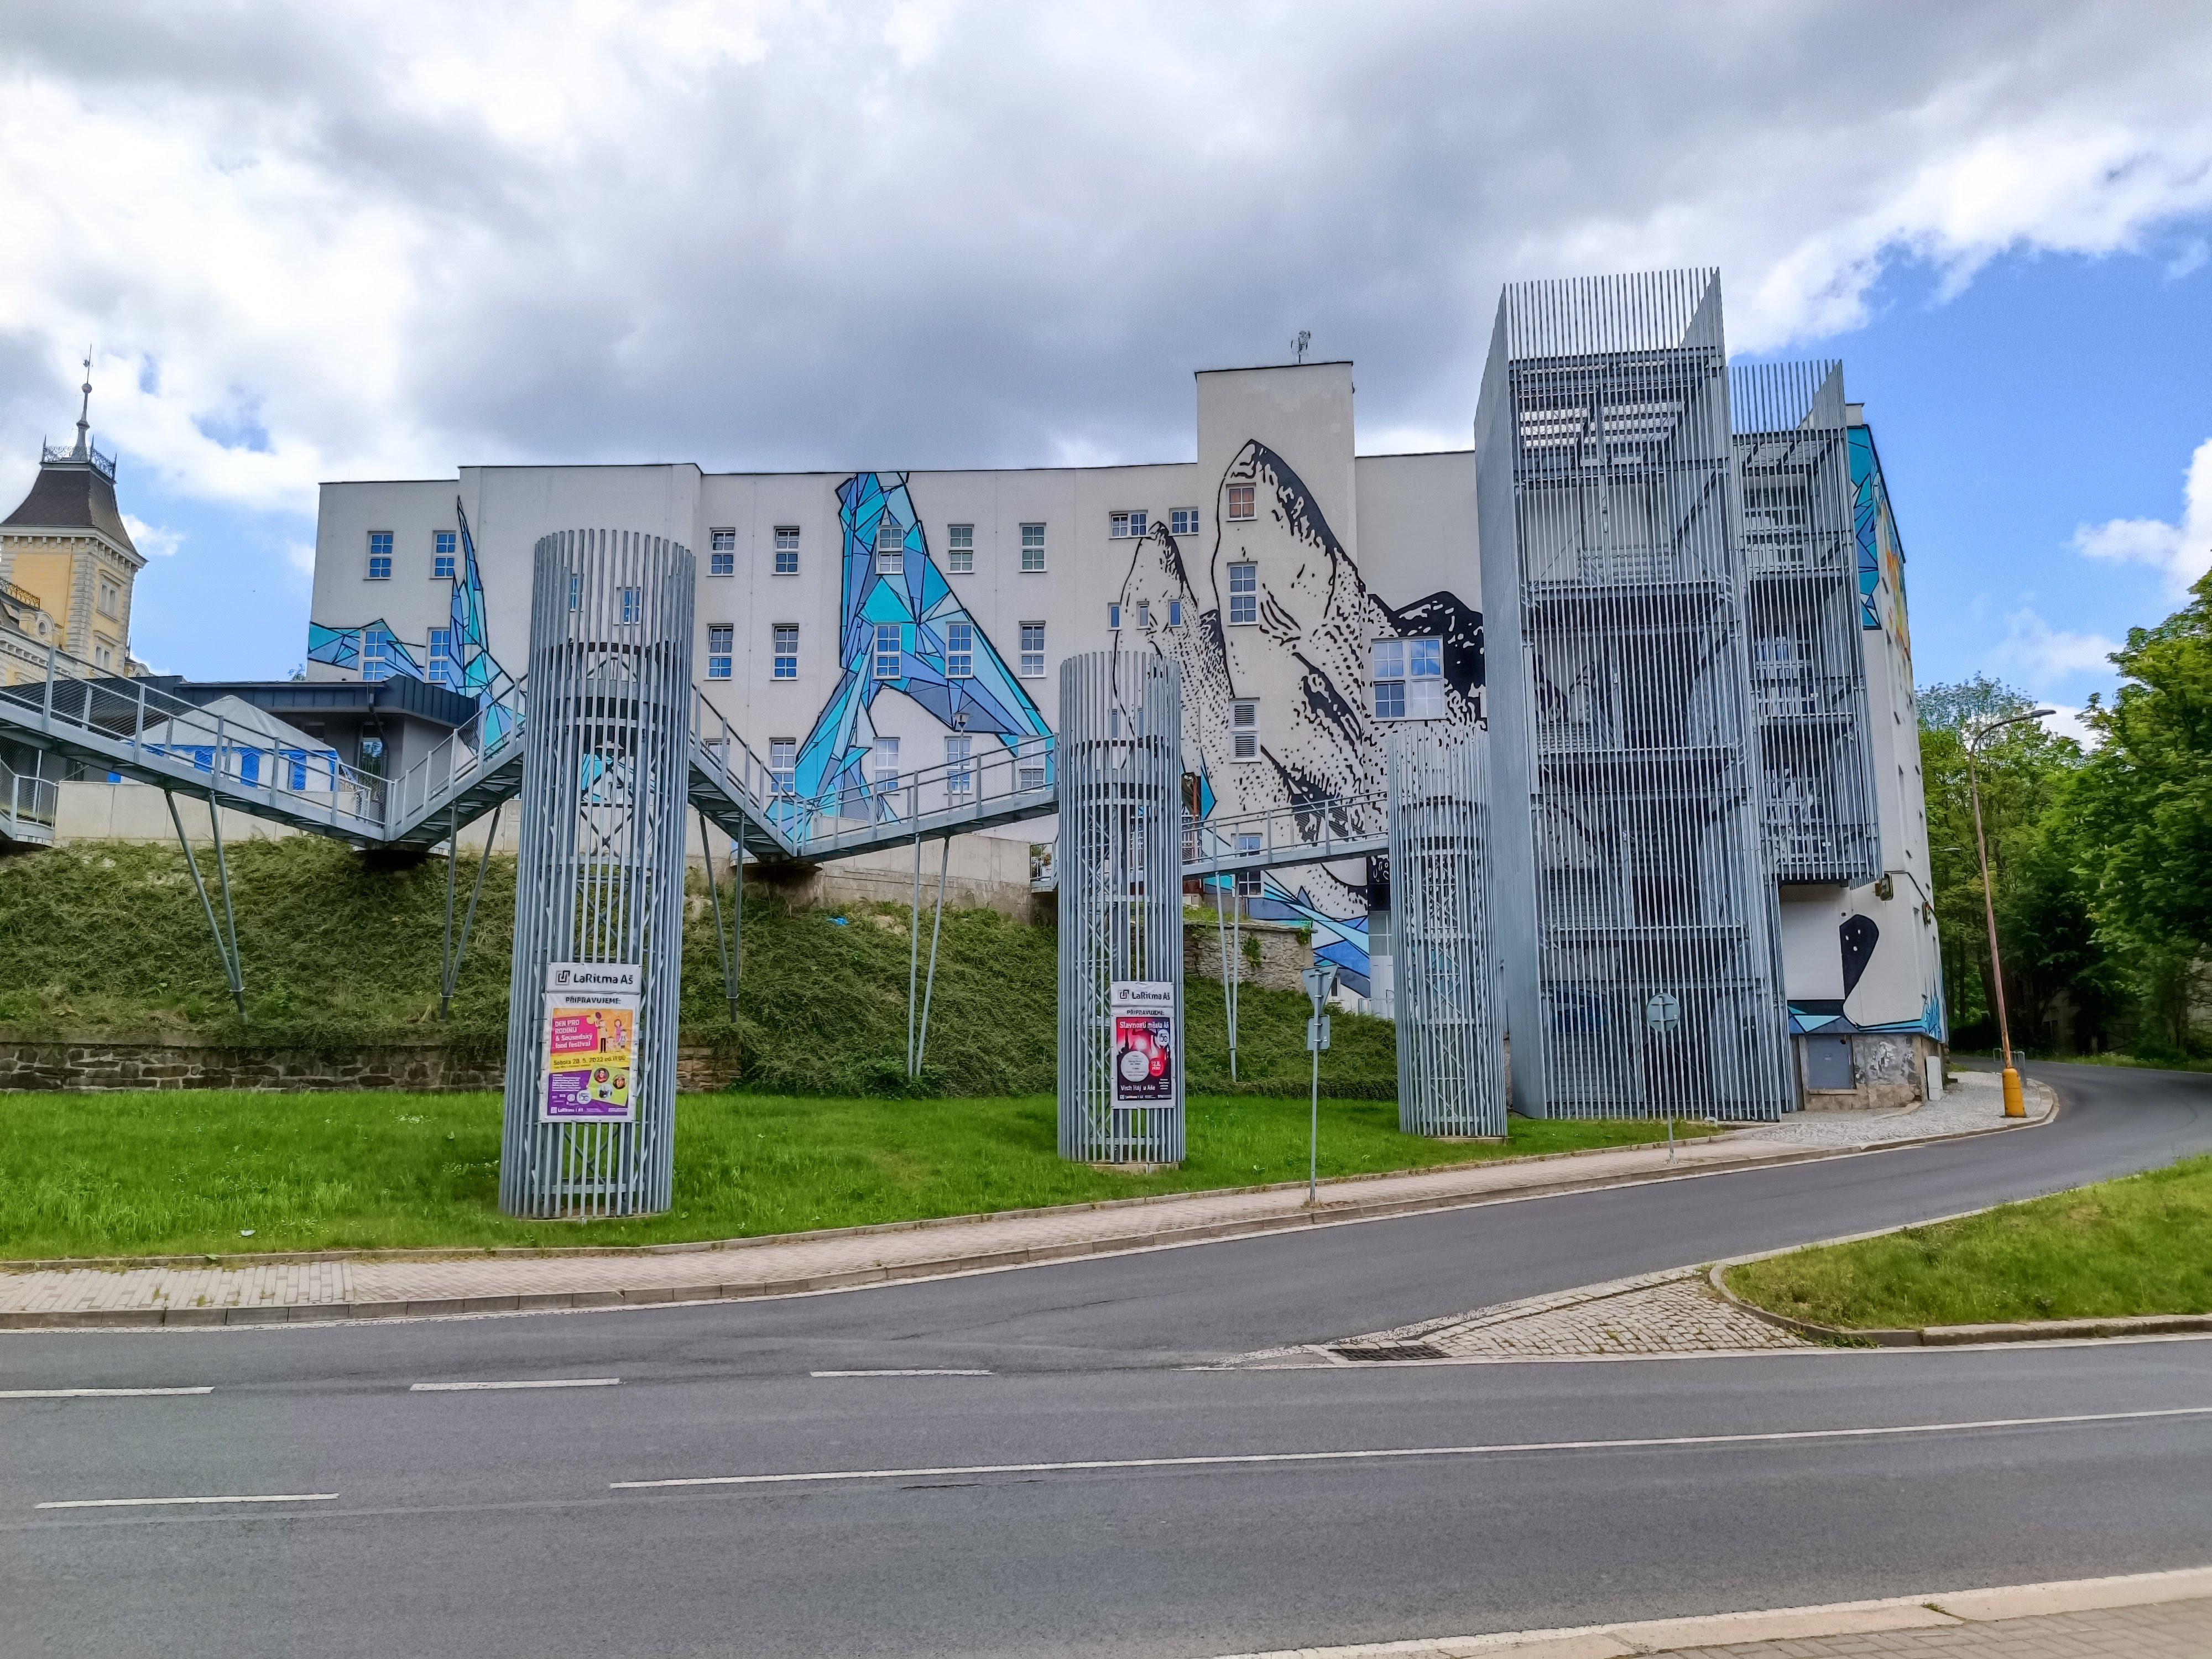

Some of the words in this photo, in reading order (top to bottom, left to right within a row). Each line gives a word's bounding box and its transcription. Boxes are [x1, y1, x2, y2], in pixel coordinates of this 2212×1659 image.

[573, 973, 618, 984] LaRitma
[620, 974, 633, 984] Aš
[1132, 992, 1162, 1000] LaRitma
[1163, 992, 1170, 1000] Aš
